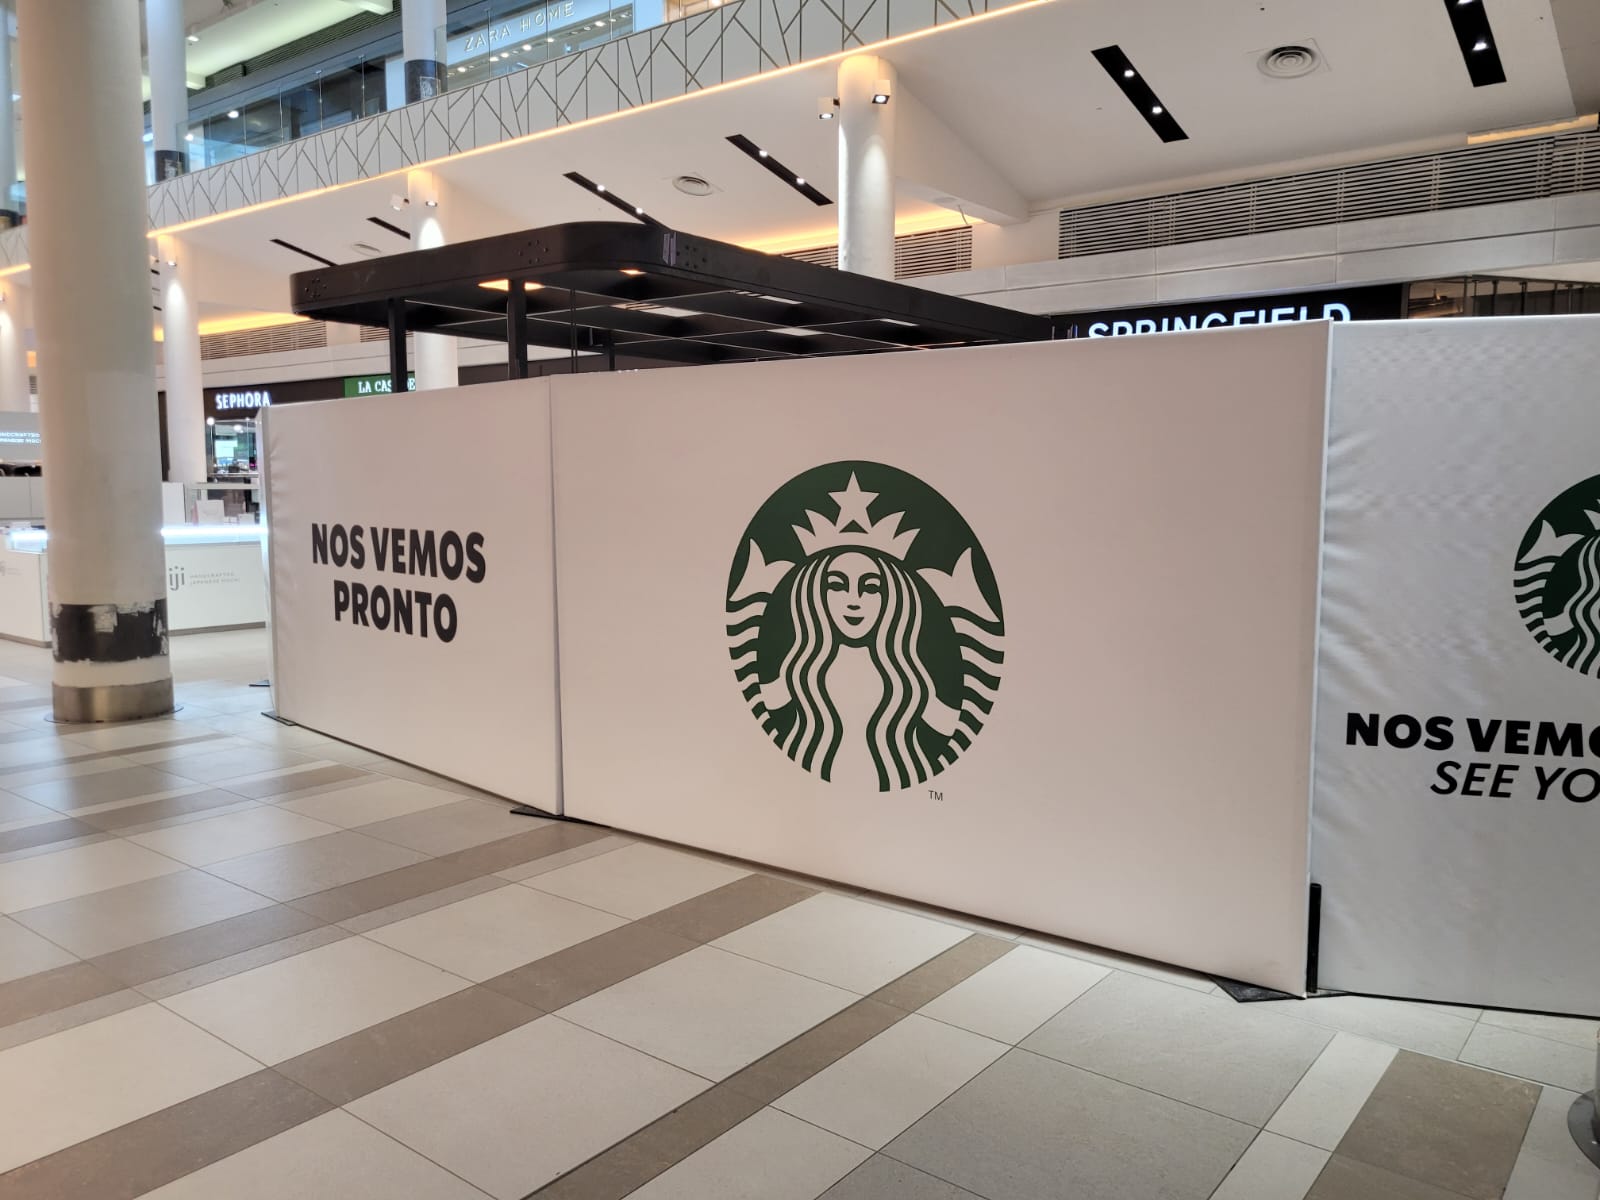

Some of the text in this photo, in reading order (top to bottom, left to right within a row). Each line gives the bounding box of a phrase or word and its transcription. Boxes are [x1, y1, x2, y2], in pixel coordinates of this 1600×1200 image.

[464, 0, 575, 51] ZARA HOME
[215, 390, 271, 410] SEPHORA
[358, 381, 372, 393] LA
[312, 523, 486, 583] NOS VEMOS
[334, 579, 457, 643] PRONTO
[1346, 712, 1454, 751] NOS
[928, 790, 943, 801] TM
[1430, 760, 1600, 803] SEE YO
